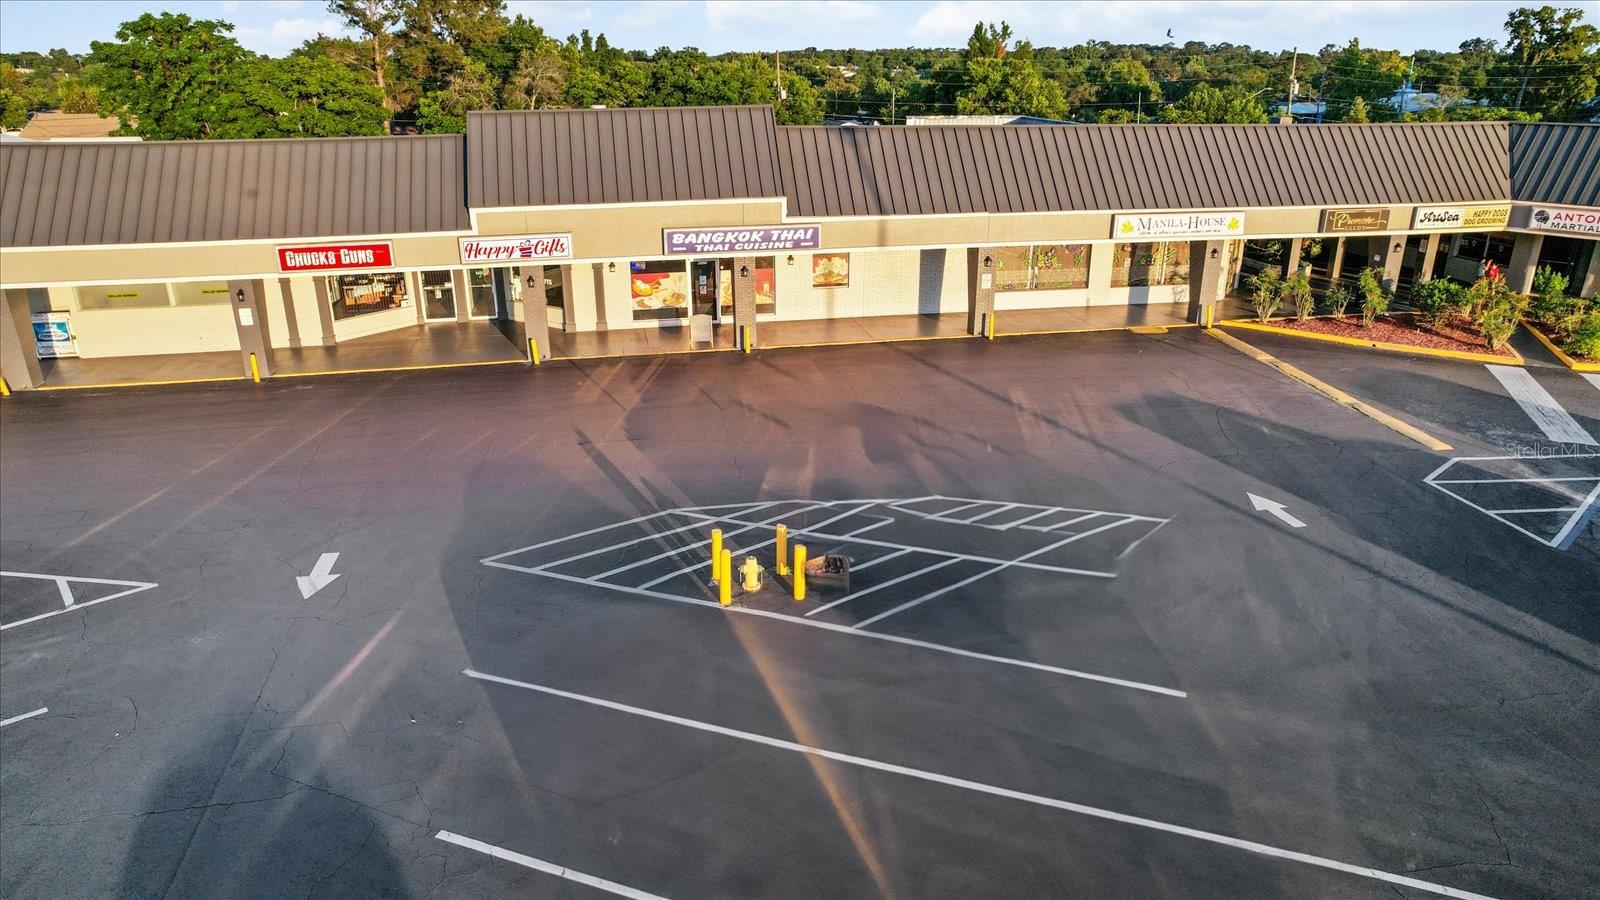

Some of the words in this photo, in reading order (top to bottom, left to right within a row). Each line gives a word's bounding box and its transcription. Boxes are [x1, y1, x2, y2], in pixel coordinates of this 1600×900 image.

[1419, 211, 1460, 223] ArtSea
[1473, 209, 1492, 218] HAPPY
[1492, 209, 1508, 217] DOGS
[1552, 212, 1600, 225] ANTO
[1477, 217, 1506, 225] GROOMING
[1550, 222, 1600, 233] MARTIAL
[672, 230, 765, 244] BANGKOK
[770, 228, 814, 240] THAI
[464, 242, 516, 259] Happy
[533, 238, 566, 256] Gifts
[694, 243, 729, 252] THAI
[734, 241, 794, 250] CUISINE
[285, 250, 337, 267] CHUCKS
[340, 248, 375, 264] GUNS
